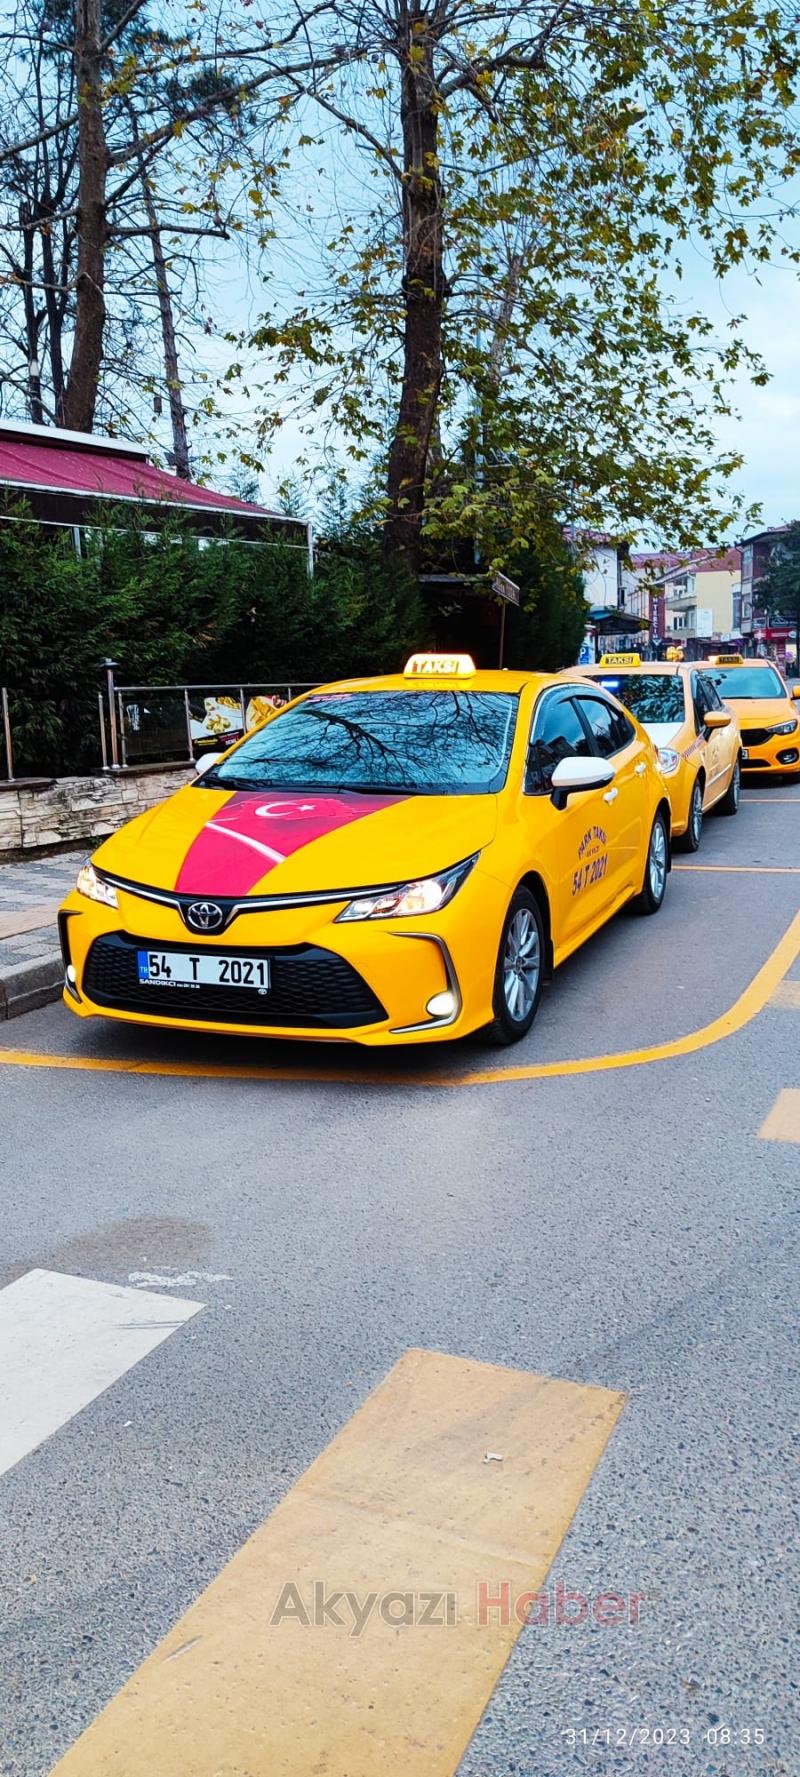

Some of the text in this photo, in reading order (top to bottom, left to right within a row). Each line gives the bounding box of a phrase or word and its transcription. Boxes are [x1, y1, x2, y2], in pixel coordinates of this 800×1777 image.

[572, 852, 608, 897] 54 T 2021
[149, 954, 265, 986] 54 T 2021
